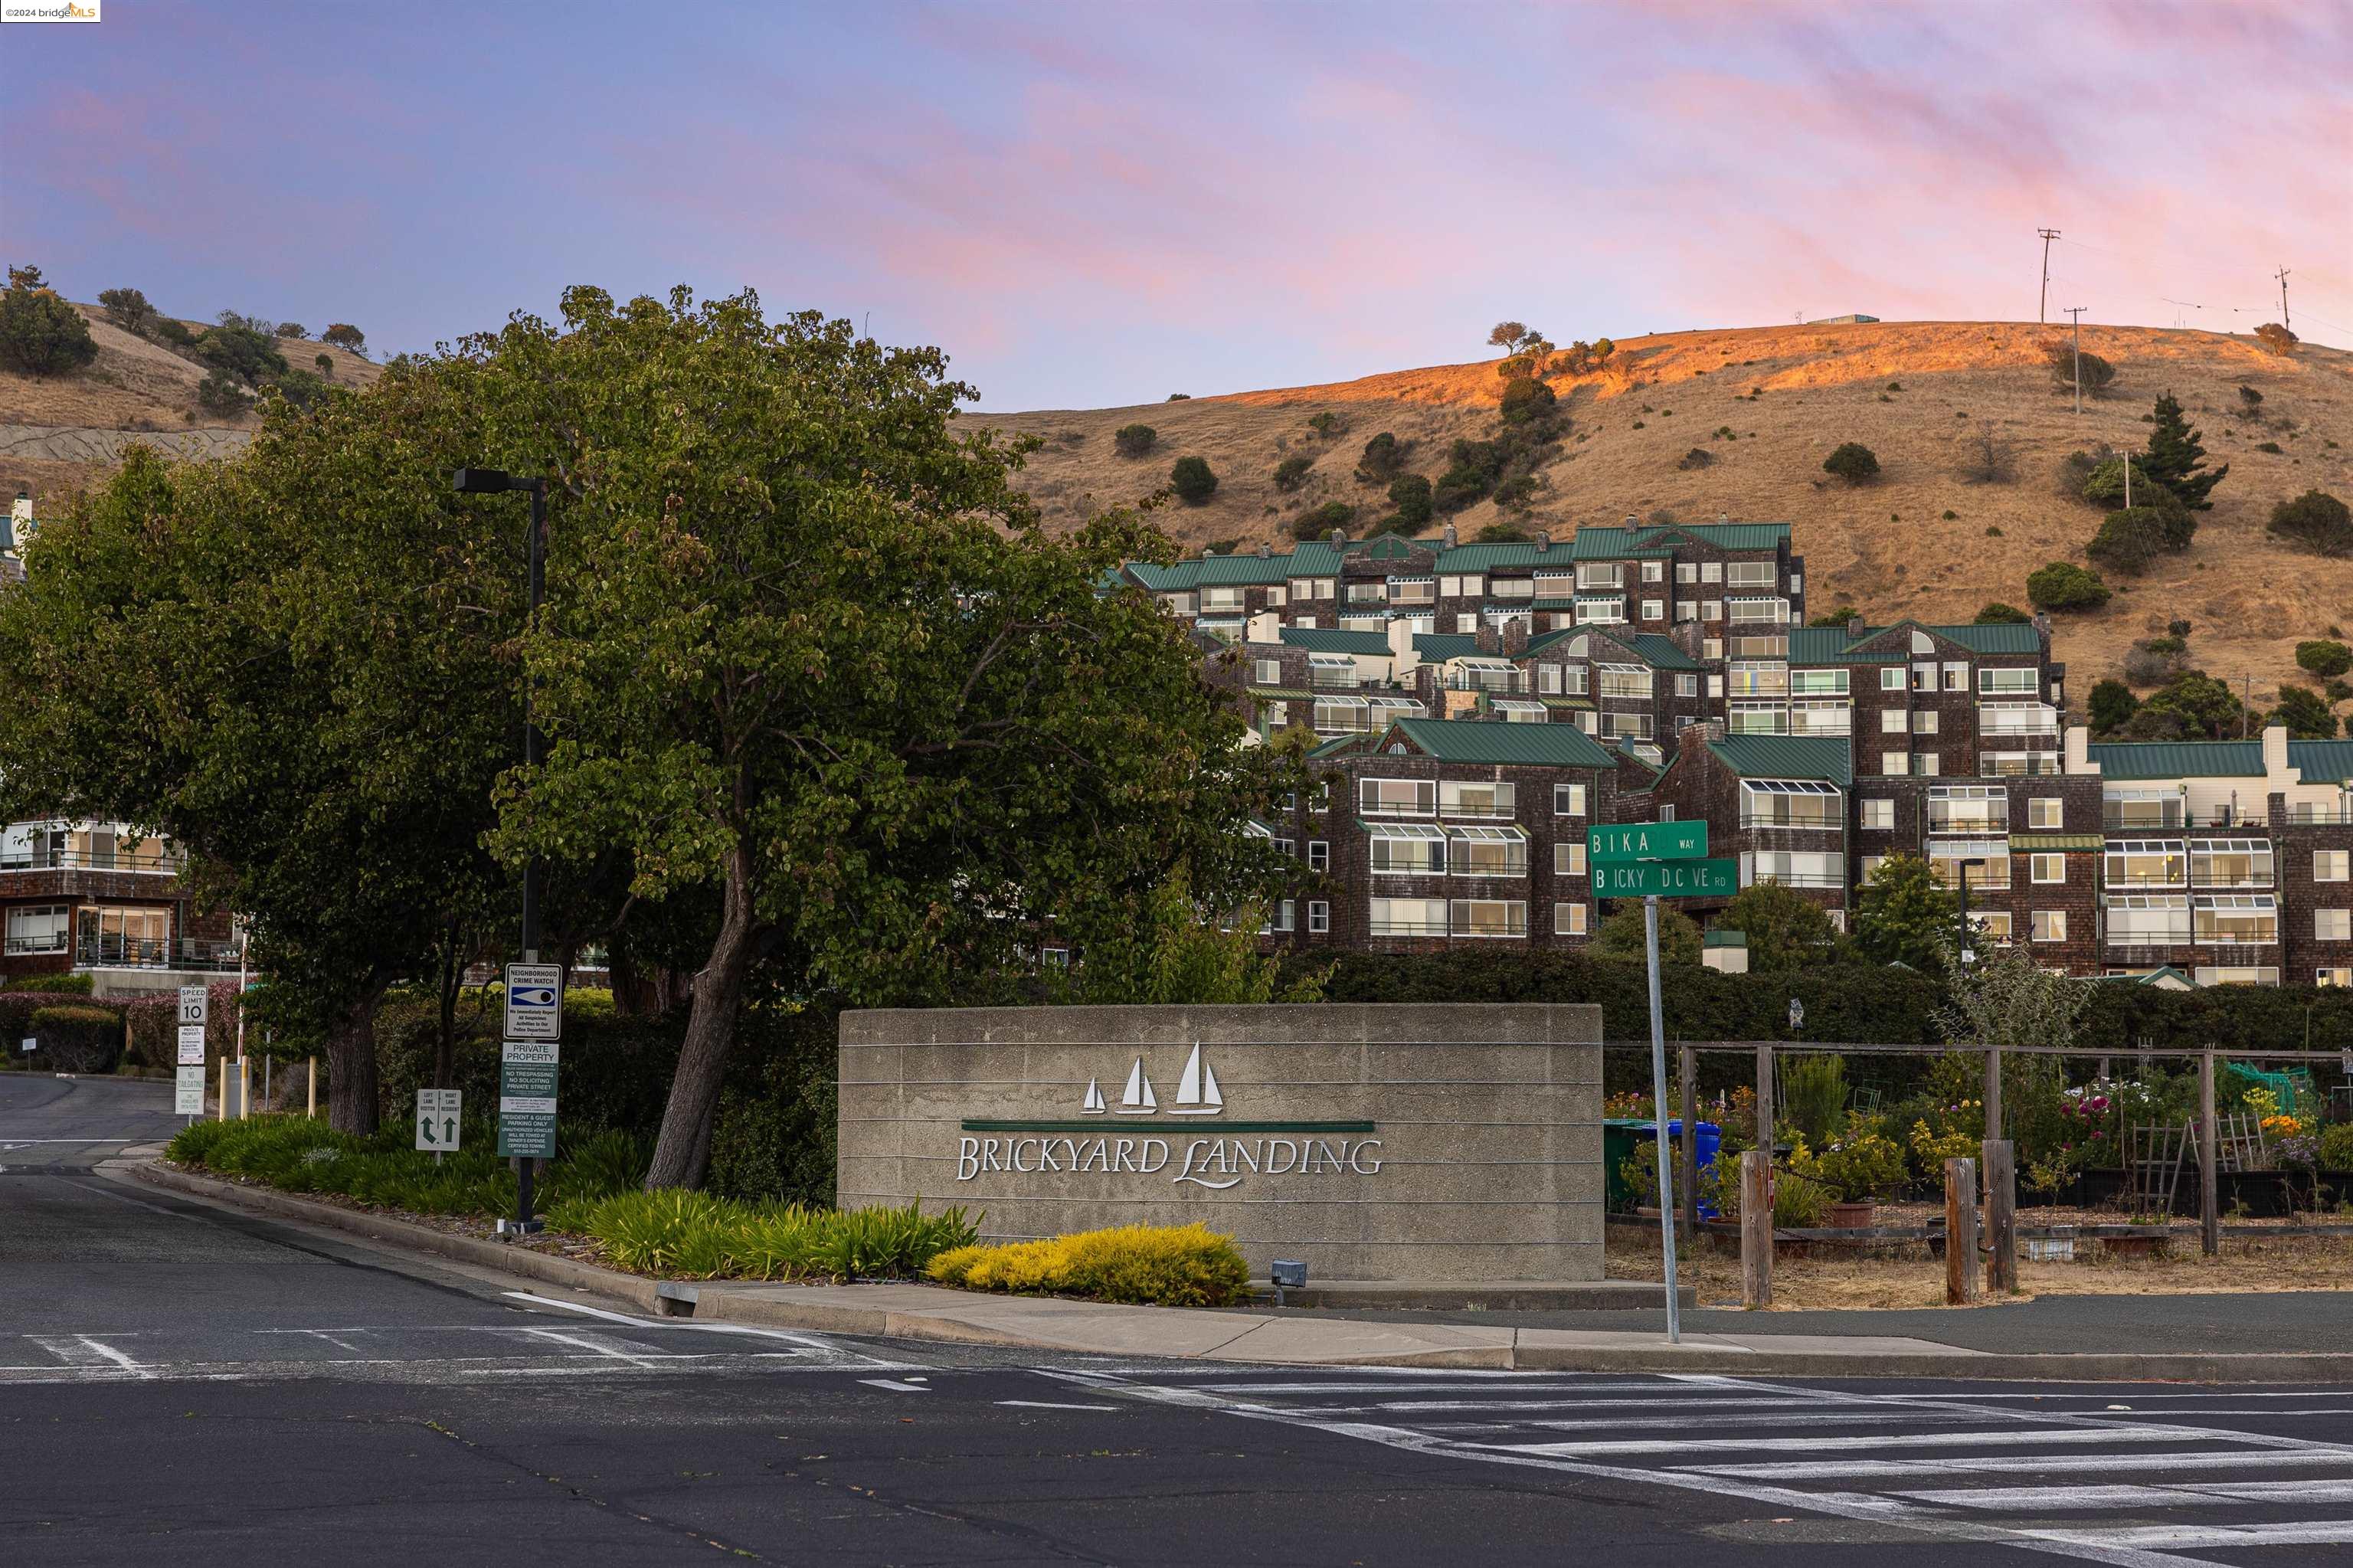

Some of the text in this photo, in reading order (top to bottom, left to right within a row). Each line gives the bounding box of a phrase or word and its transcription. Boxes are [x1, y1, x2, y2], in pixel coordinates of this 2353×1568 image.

[1679, 839, 1695, 849] WAY
[1675, 868, 1709, 888] CVE
[1715, 876, 1726, 887] RD
[184, 1006, 201, 1019] 10
[513, 1045, 548, 1053] PRIVATE
[506, 1053, 555, 1062] PROPERTY
[956, 1138, 1383, 1189] BRICKYARD LANDING
